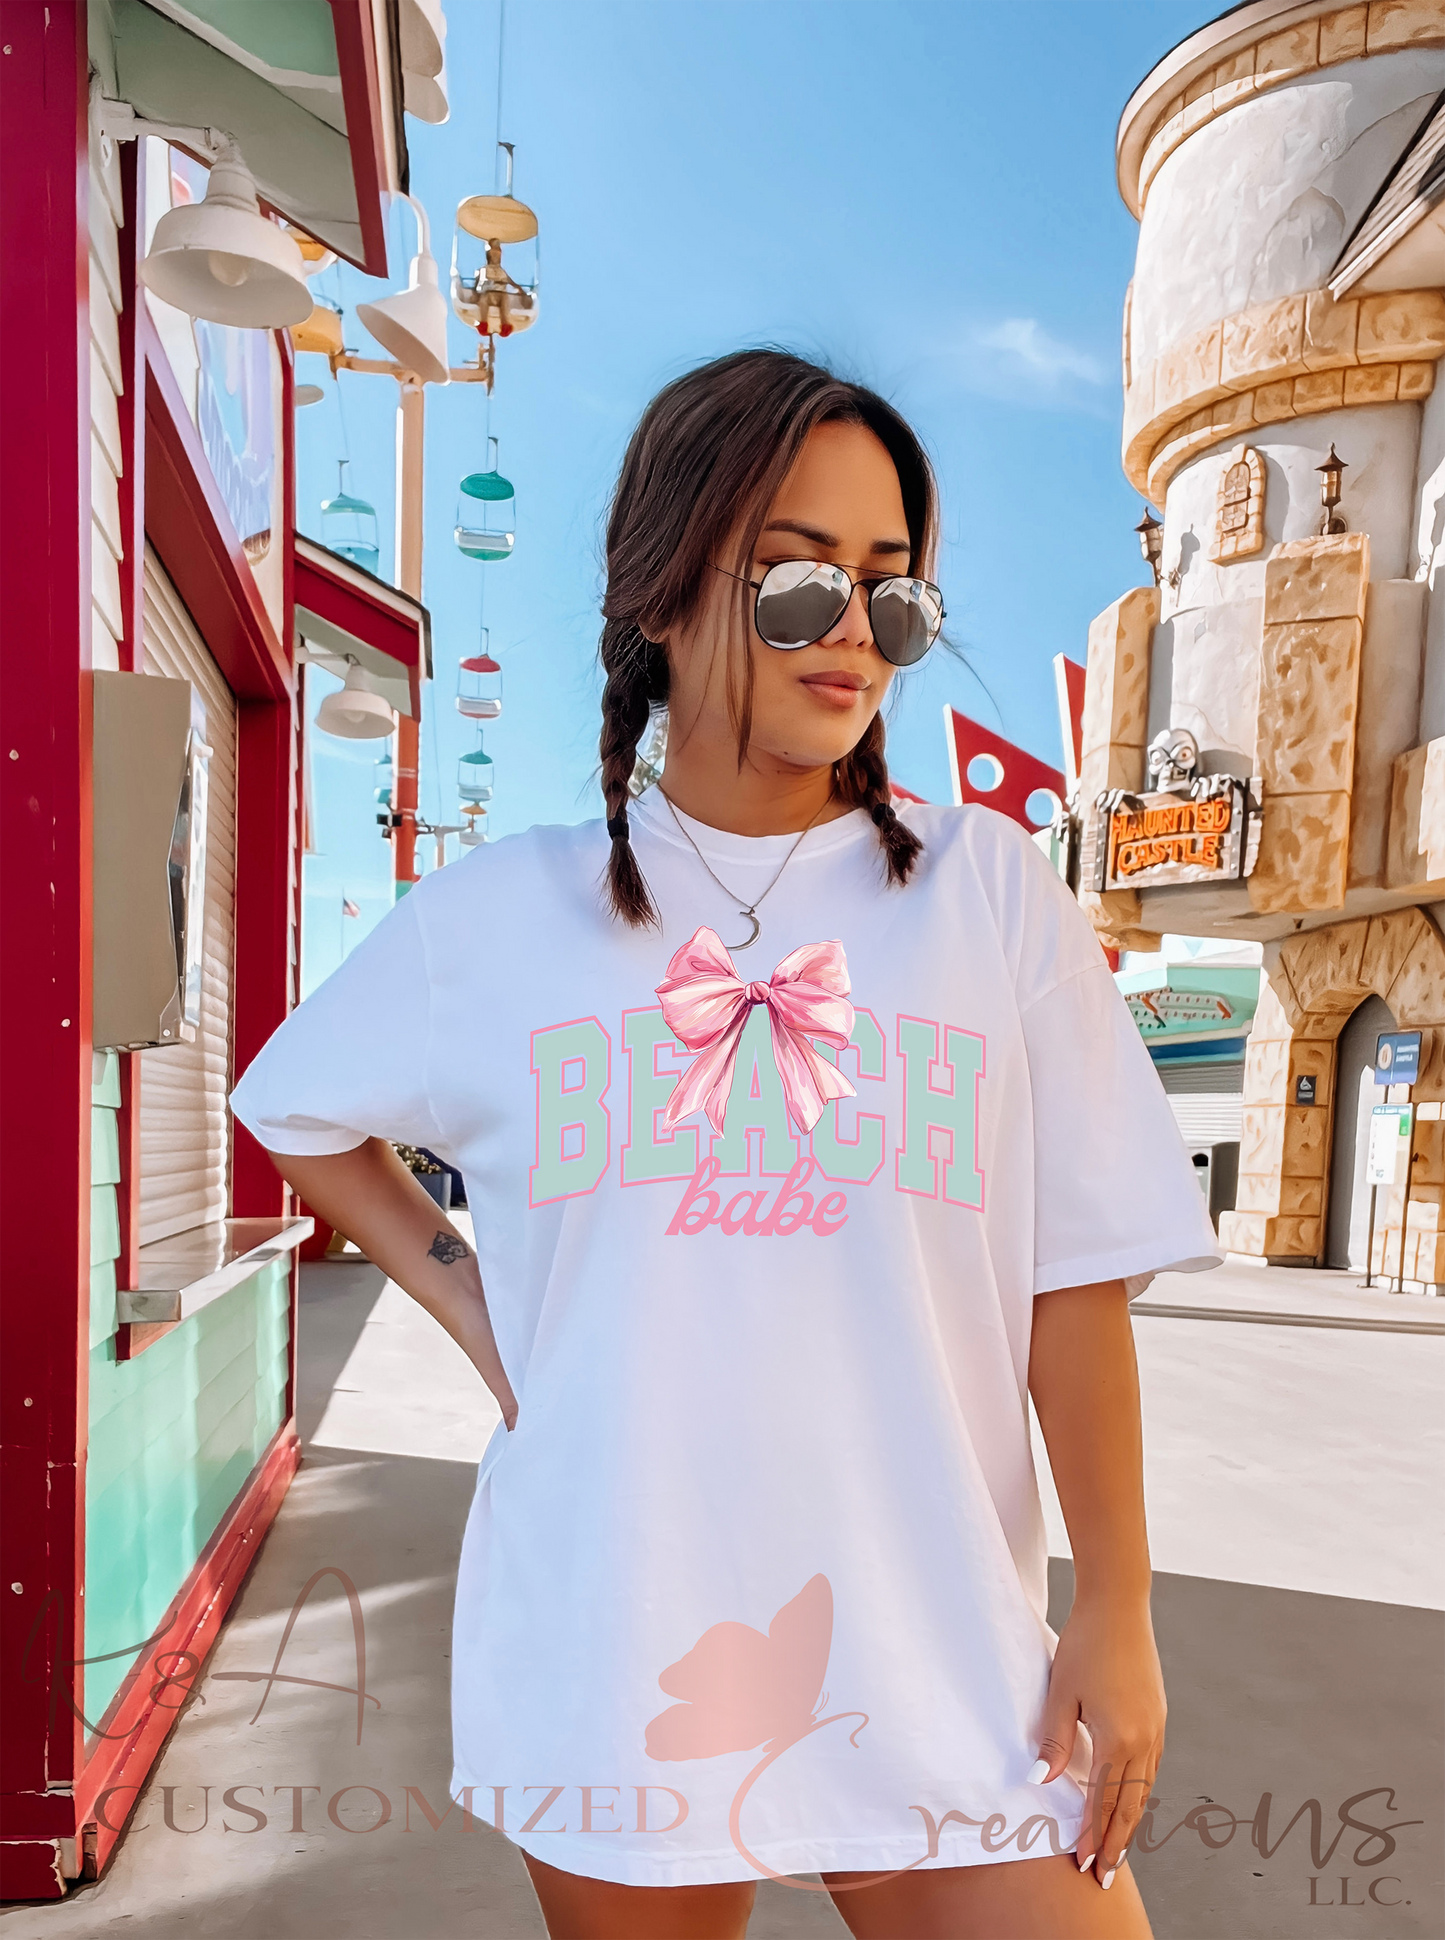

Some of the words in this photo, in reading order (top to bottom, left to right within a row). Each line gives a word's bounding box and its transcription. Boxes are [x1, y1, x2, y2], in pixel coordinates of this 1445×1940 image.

[1110, 798, 1231, 860] HAUNTED
[1117, 835, 1219, 876] CASTLE
[529, 1006, 986, 1213] BEACH
[664, 1156, 850, 1237] babe
